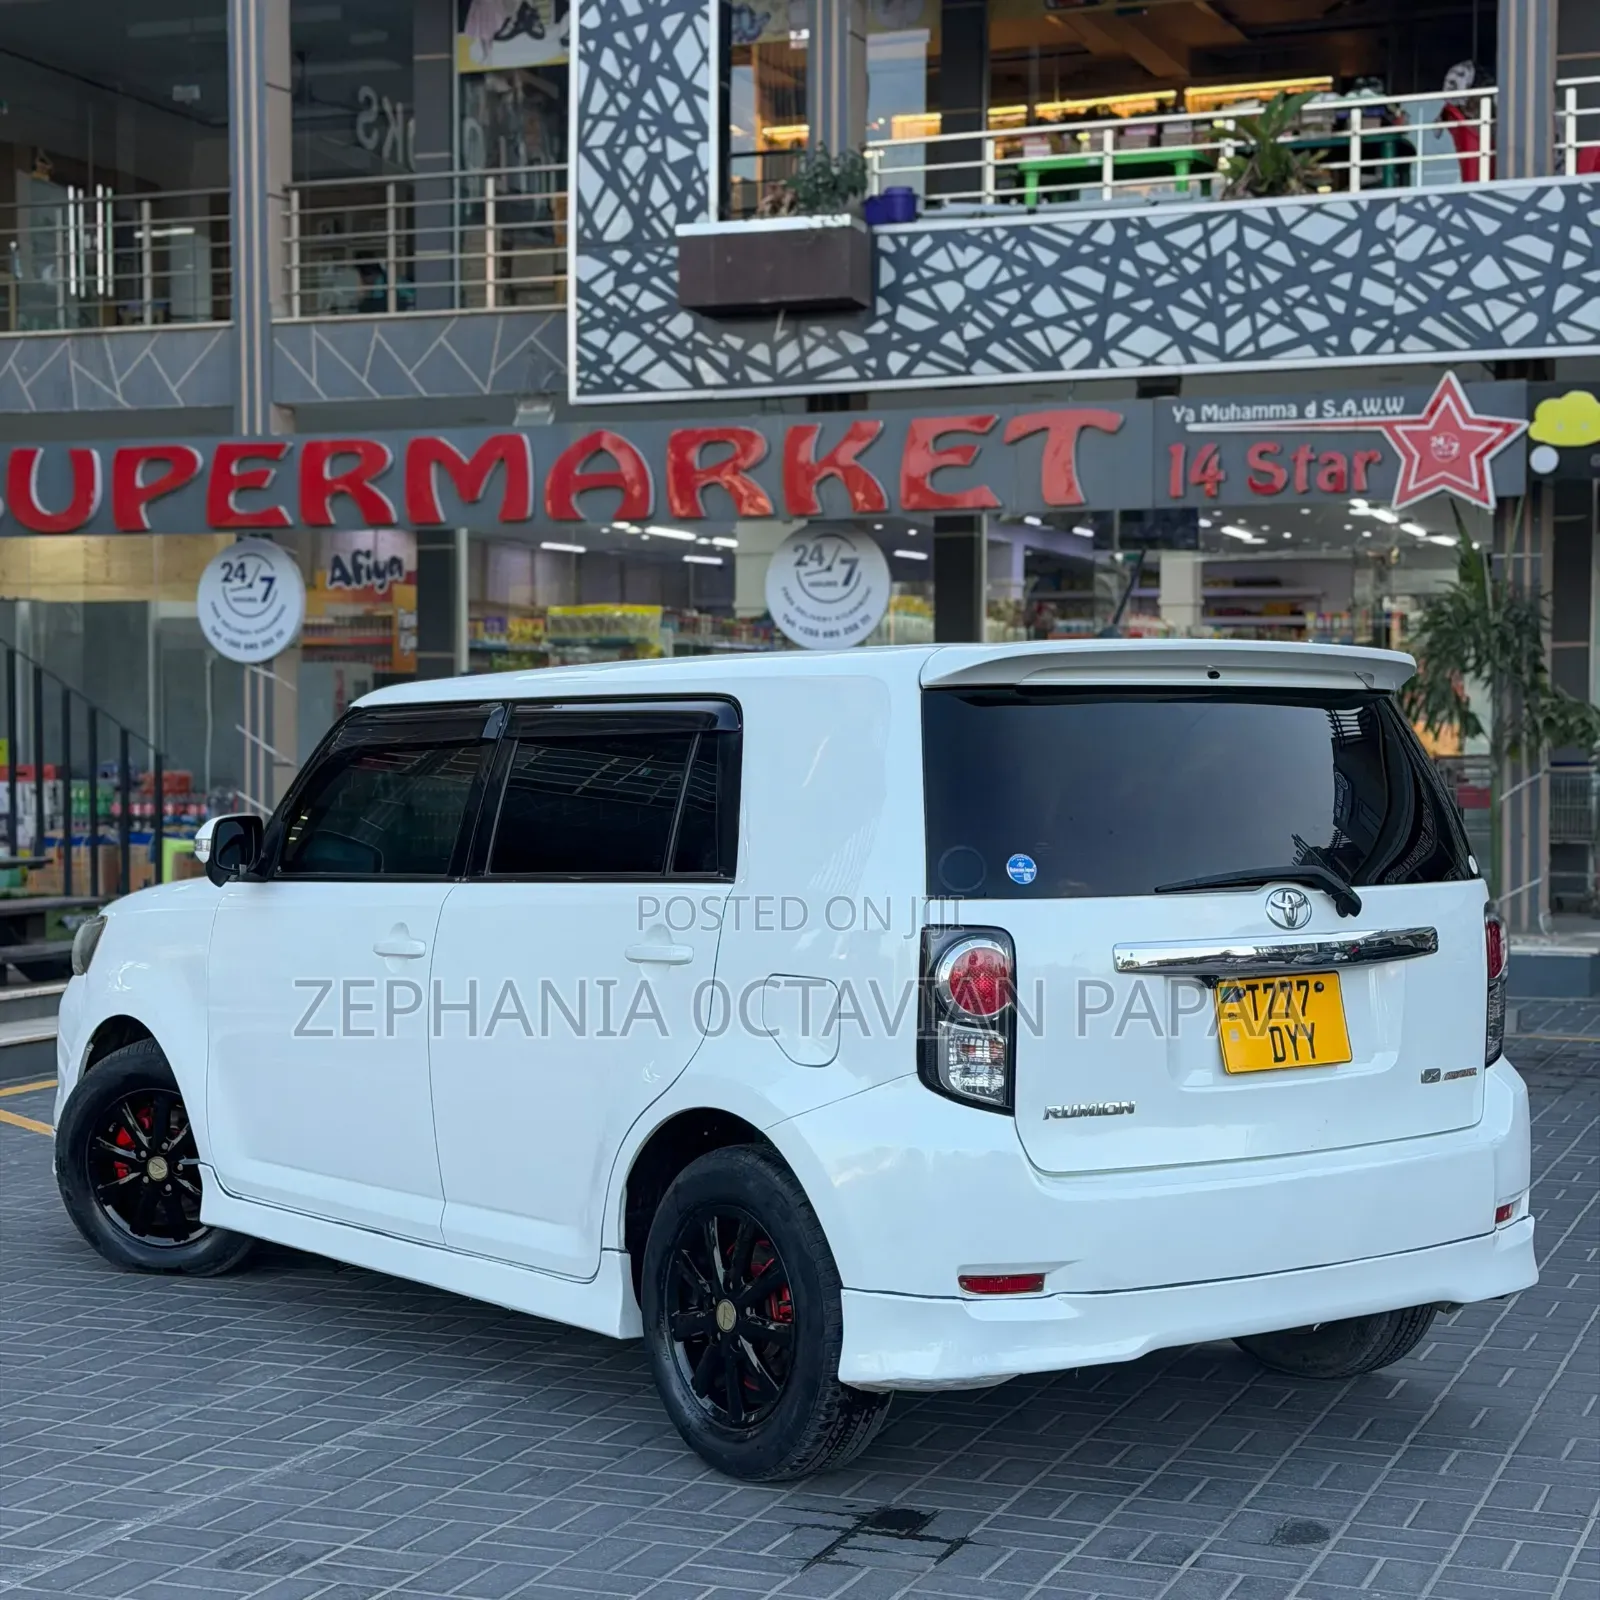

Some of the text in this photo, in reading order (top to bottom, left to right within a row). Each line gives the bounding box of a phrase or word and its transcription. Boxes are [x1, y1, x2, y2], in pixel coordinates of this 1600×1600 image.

[1172, 405, 1196, 423] Ya
[1322, 397, 1405, 418] S.A.W.W
[0, 409, 1124, 533] UPERMARKET
[1168, 441, 1382, 498] 14 Star
[328, 549, 405, 590] Afiya
[1246, 980, 1310, 1022] T777
[1268, 1022, 1316, 1063] DYY
[1043, 1100, 1136, 1121] RUMION
